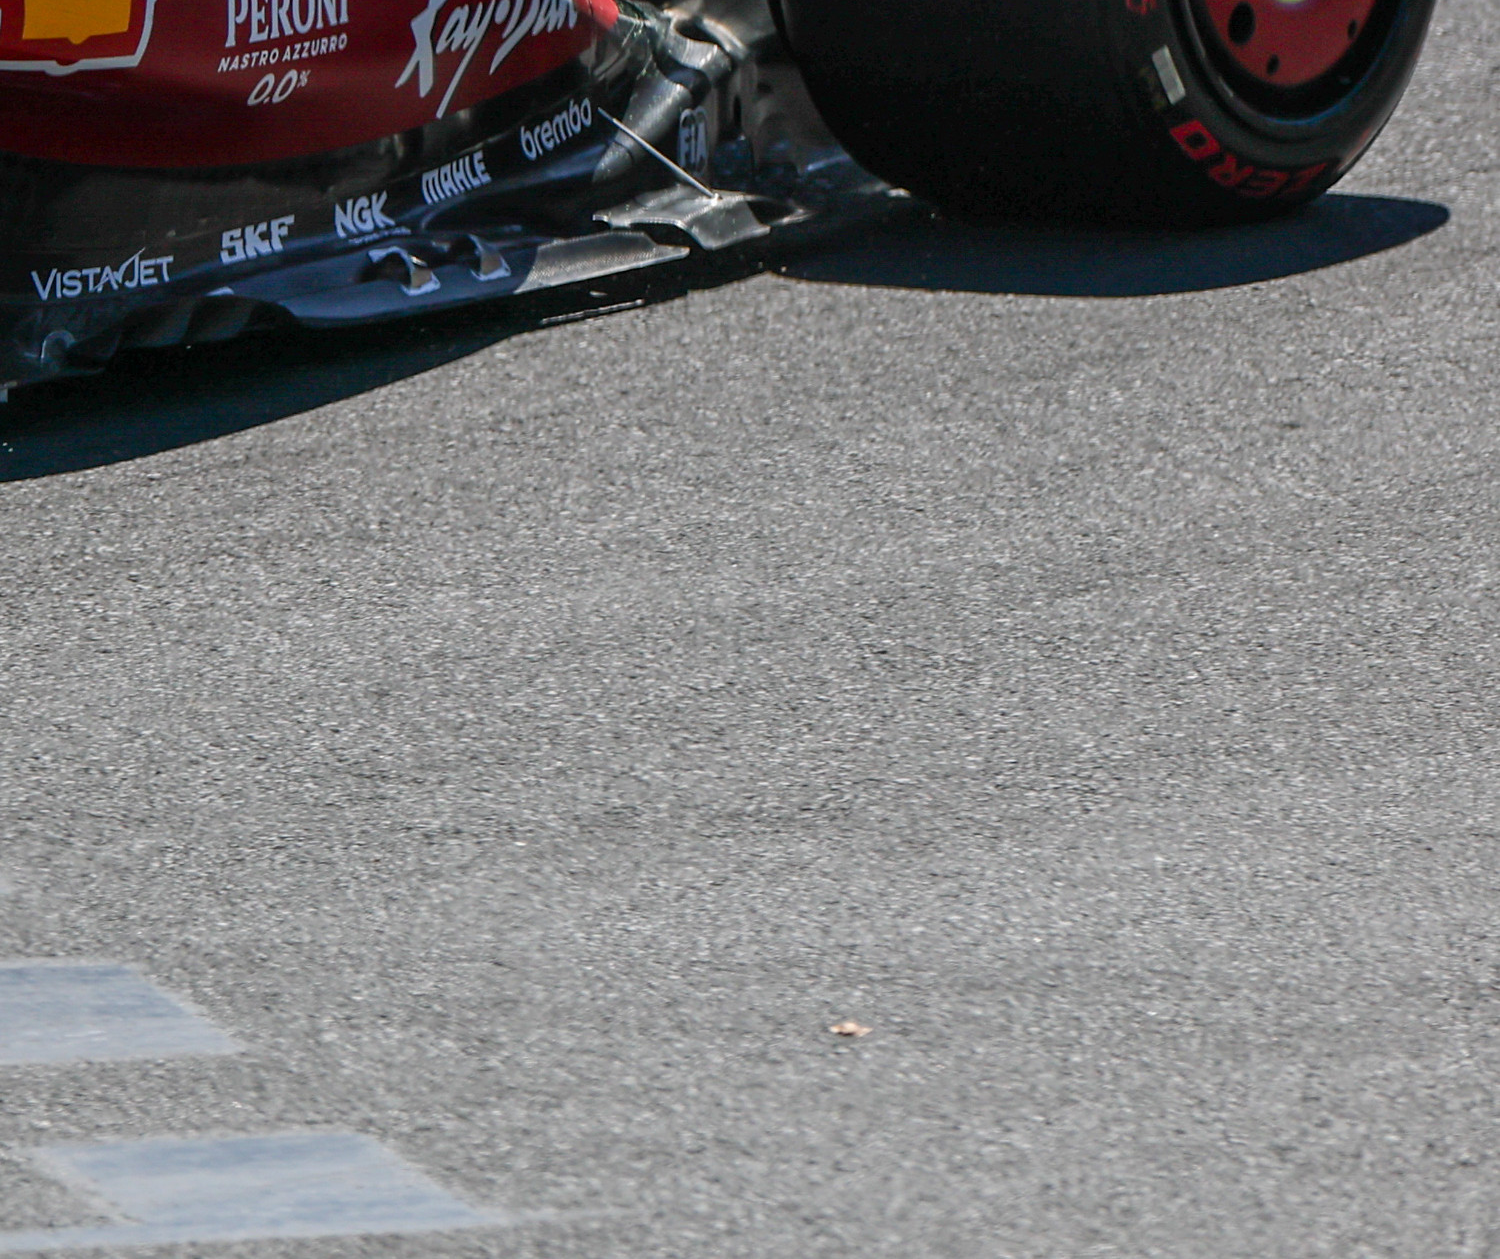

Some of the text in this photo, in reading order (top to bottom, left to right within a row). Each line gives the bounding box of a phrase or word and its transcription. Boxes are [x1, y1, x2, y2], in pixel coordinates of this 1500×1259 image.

[217, 33, 348, 73] NASTRO AZZURRO
[520, 97, 593, 162] brembo
[679, 122, 708, 167] FIA
[422, 150, 492, 205] MAHLE
[334, 190, 396, 239] NGK
[221, 215, 295, 265] SKF
